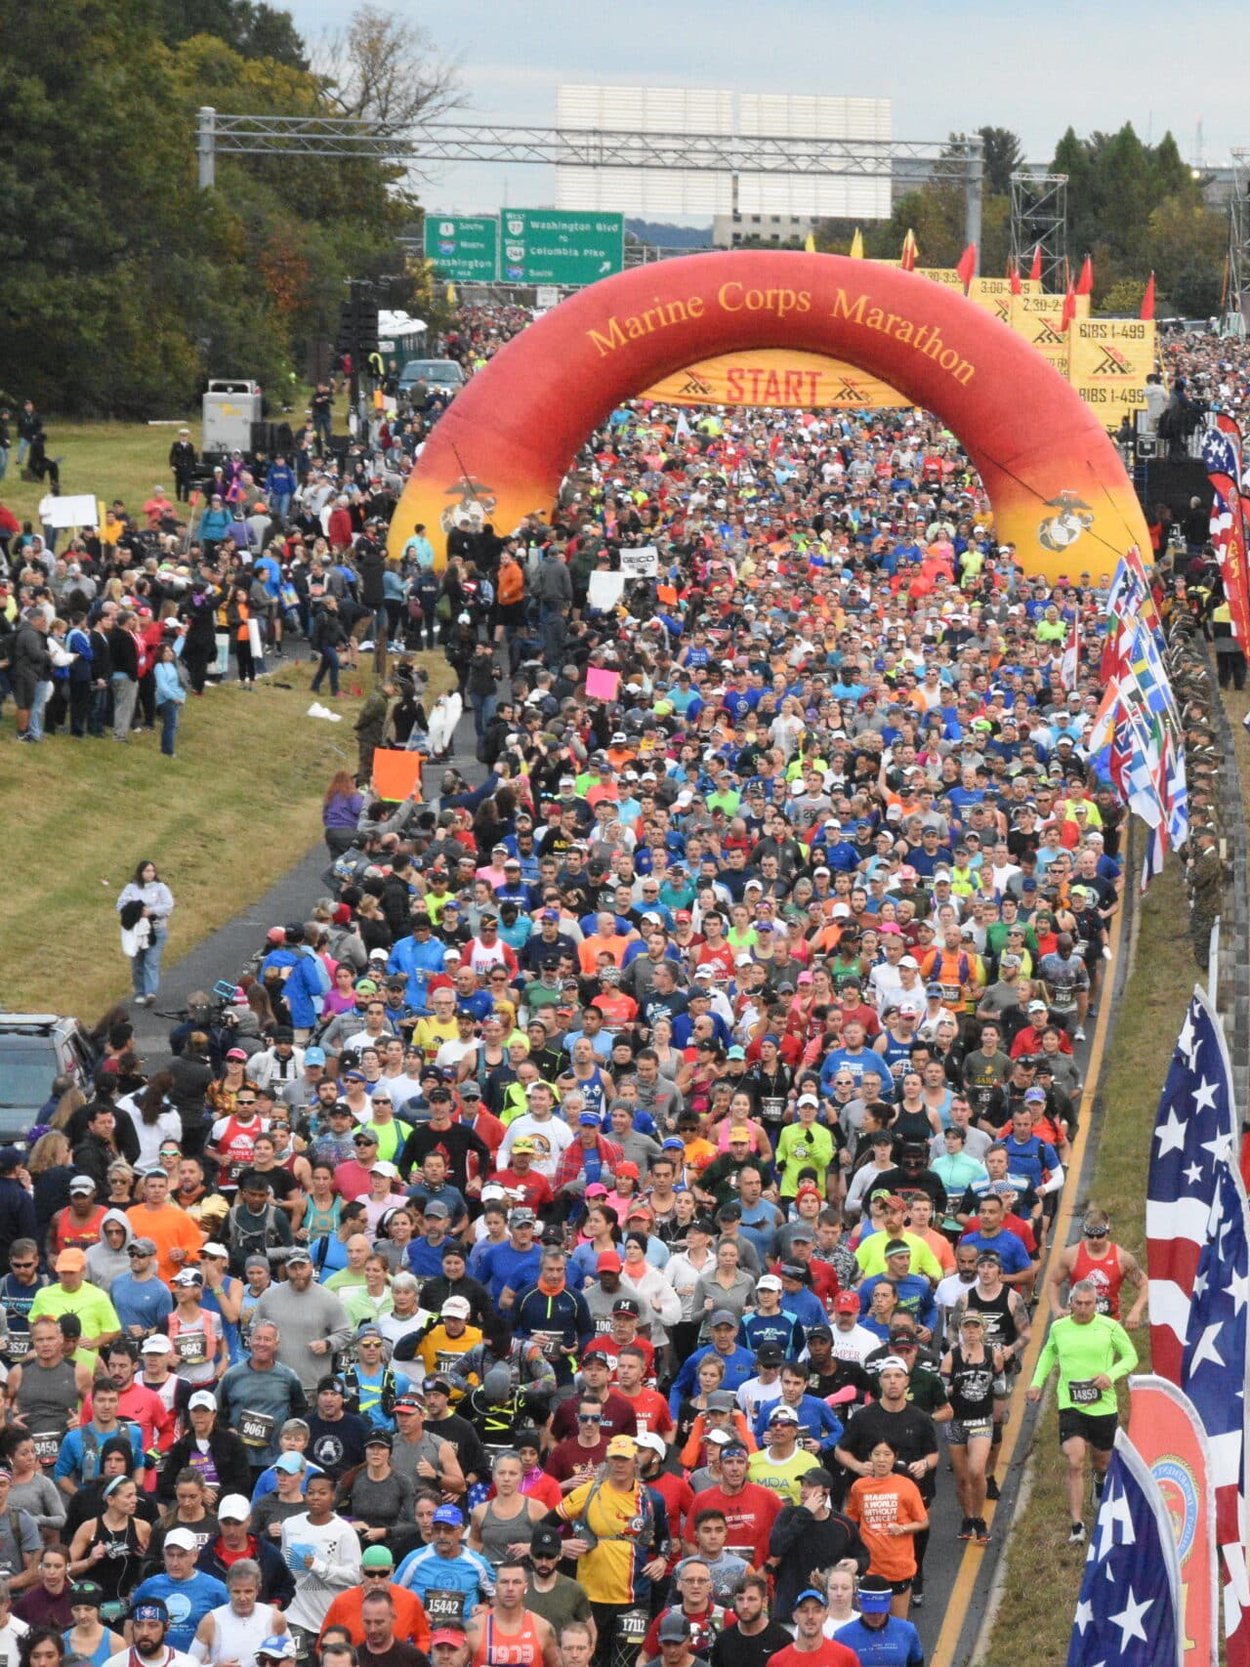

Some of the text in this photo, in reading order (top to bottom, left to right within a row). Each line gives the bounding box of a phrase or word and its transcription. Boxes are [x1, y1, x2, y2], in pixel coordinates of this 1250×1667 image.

[530, 220, 619, 232] Washington Blvd
[530, 247, 606, 257] Columbia Pike
[586, 281, 977, 386] Marine Corps Marathon
[1111, 324, 1145, 339] 1-499
[726, 367, 823, 405] START
[1111, 388, 1145, 403] 1-499
[622, 555, 655, 564] GEICO
[620, 1300, 630, 1310] M
[1071, 1388, 1097, 1401] 14859
[243, 1421, 266, 1437] 9061
[756, 1476, 790, 1488] MDA
[871, 1500, 898, 1508] WORLD
[428, 1599, 459, 1614] 15442
[491, 1643, 535, 1665] 1973
